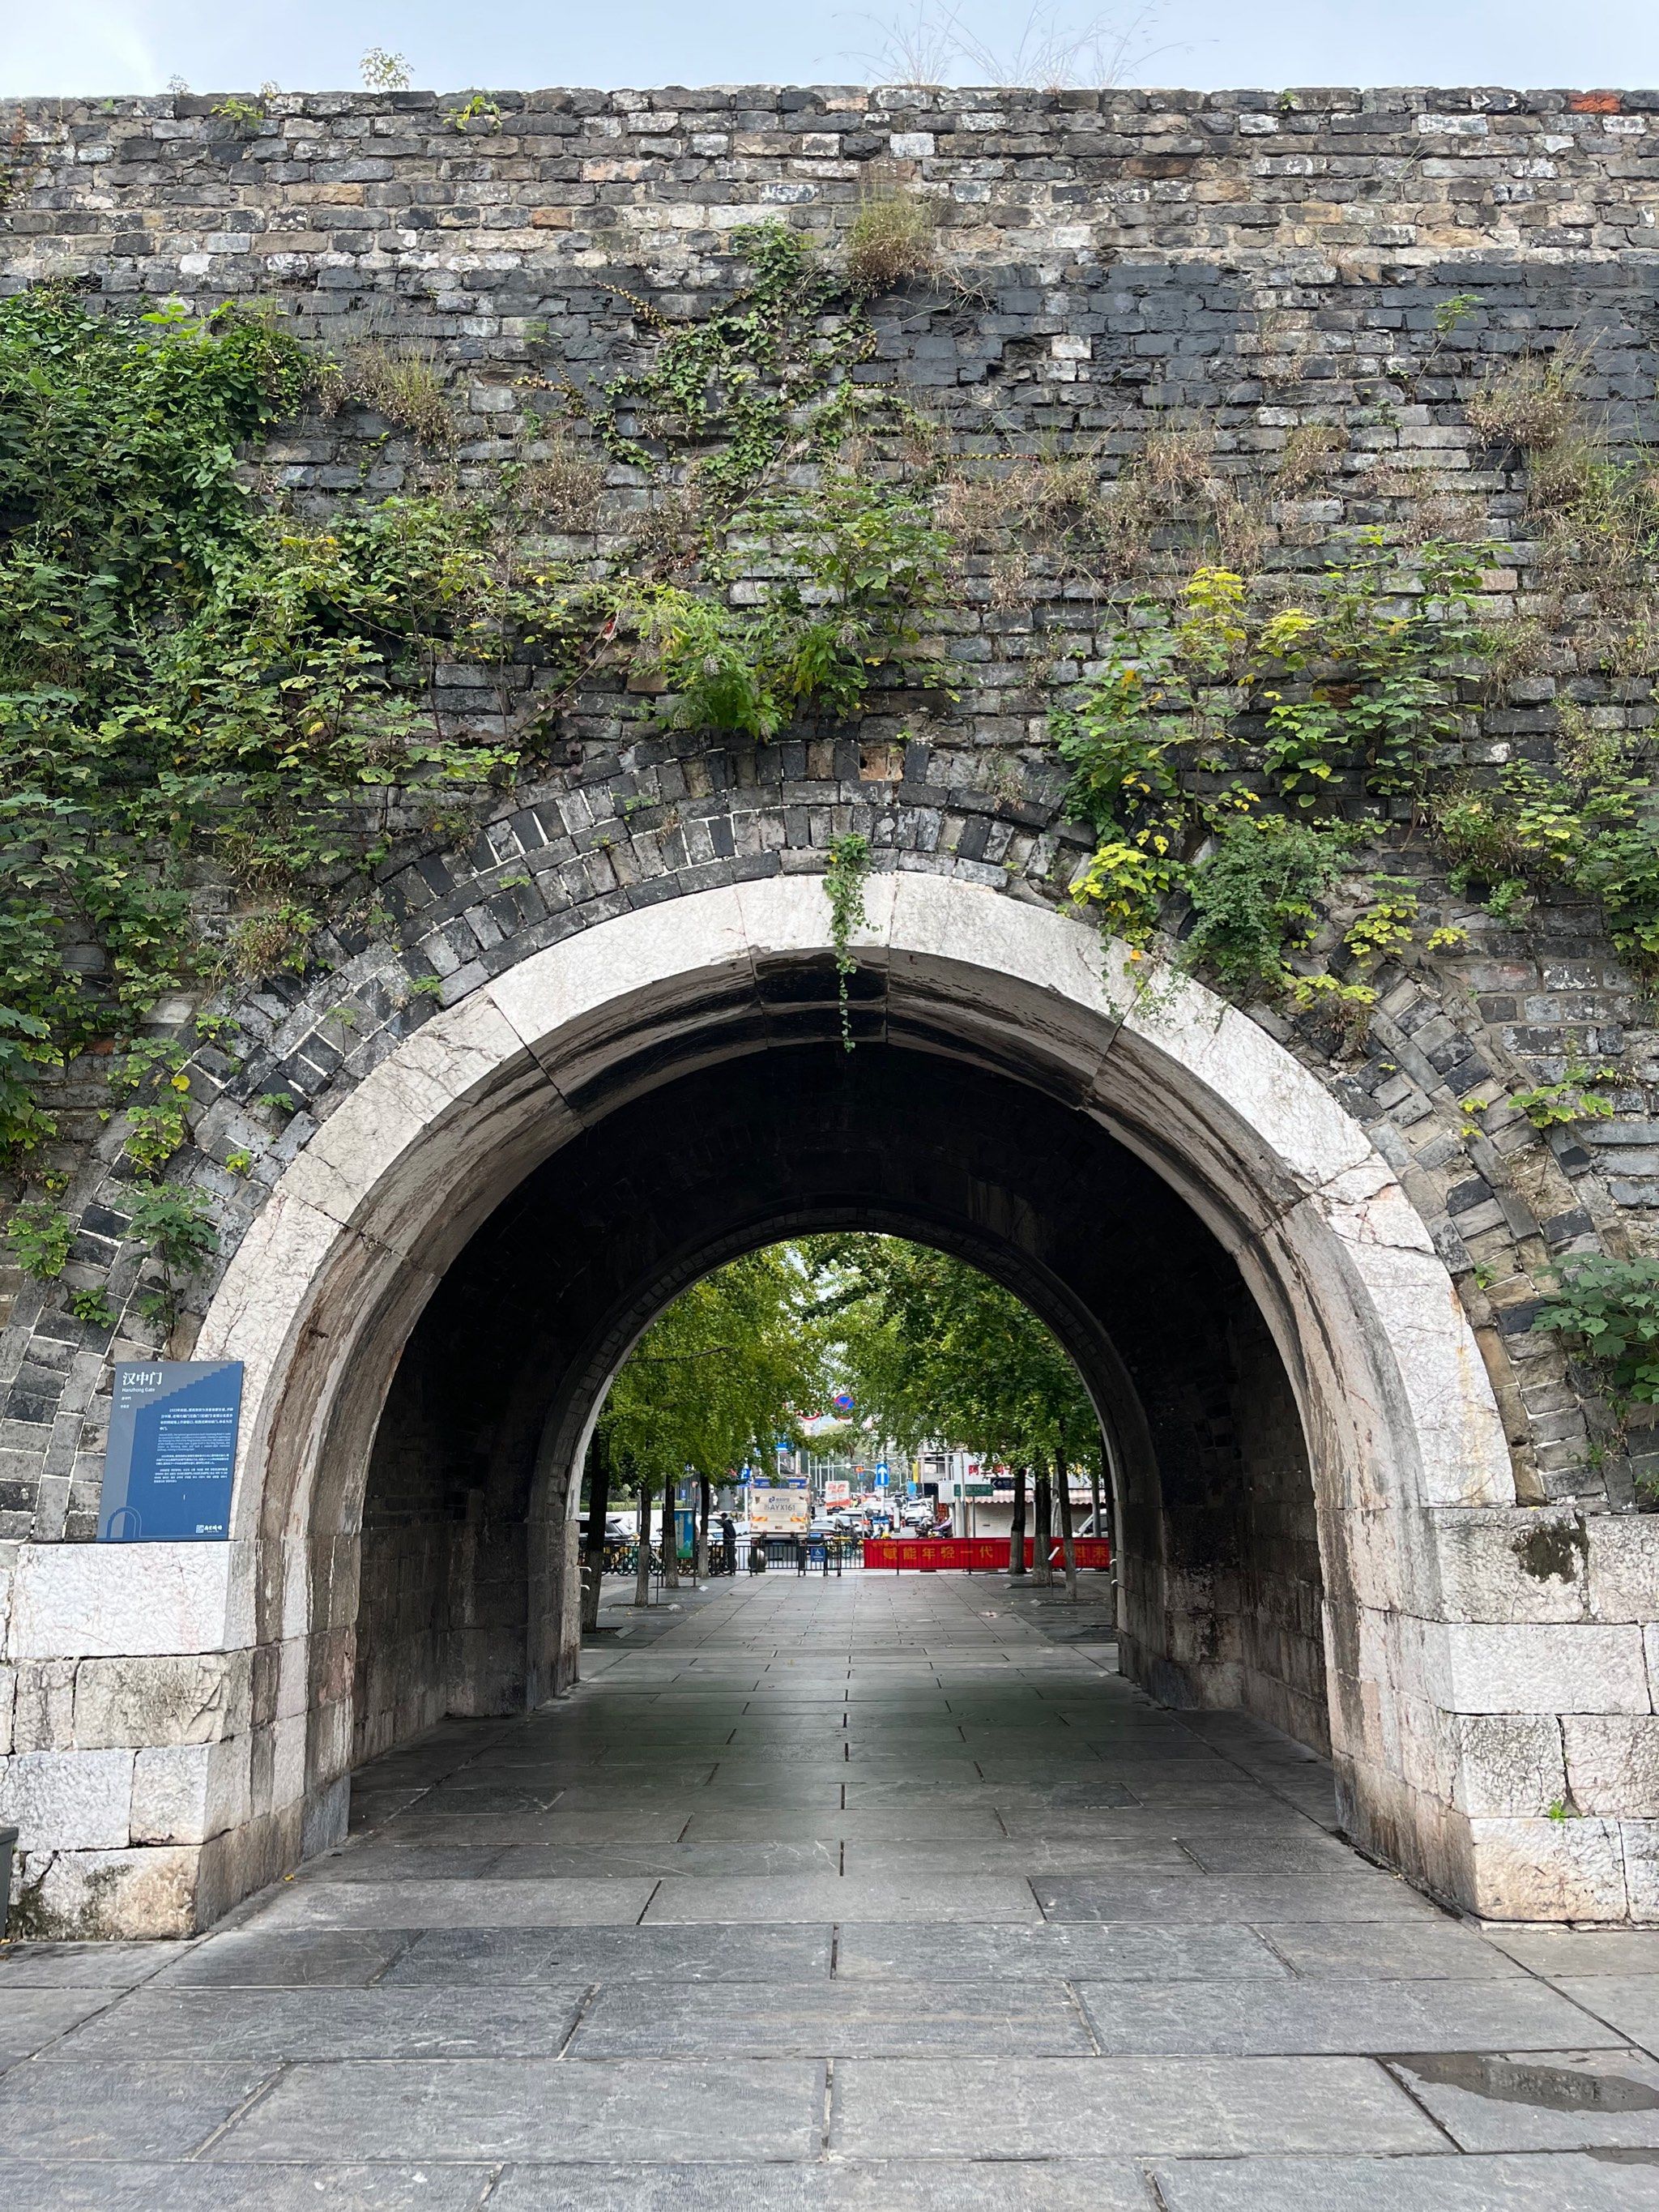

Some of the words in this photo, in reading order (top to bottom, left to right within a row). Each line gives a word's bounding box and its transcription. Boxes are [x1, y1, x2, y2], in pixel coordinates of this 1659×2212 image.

[122, 1371, 163, 1386] 汉中门
[883, 1545, 993, 1561] 赋能年轻一代
